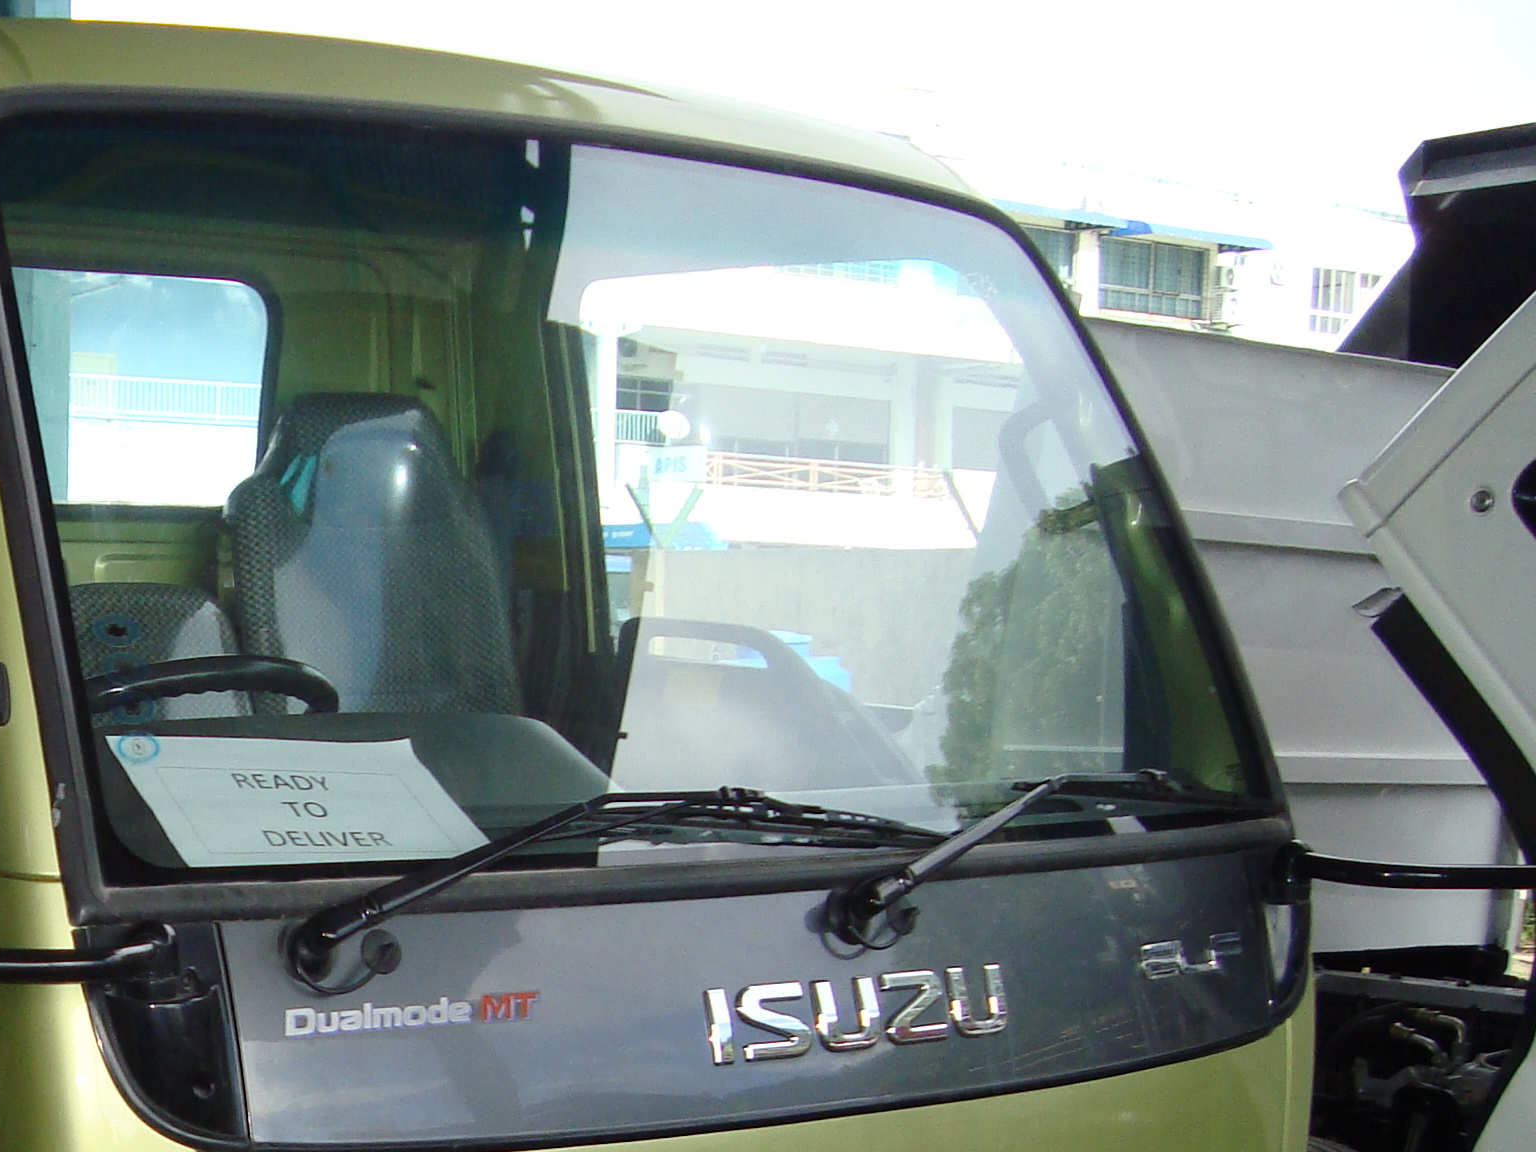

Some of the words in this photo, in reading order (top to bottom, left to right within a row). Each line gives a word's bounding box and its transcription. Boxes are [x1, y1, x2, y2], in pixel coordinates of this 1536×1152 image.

[654, 456, 687, 475] APIS
[231, 772, 330, 793] READY
[281, 800, 328, 819] TO
[262, 829, 393, 849] DELIVER
[284, 996, 473, 1038] Dualmode
[478, 989, 541, 1025] MT
[703, 961, 1008, 1067] ISUZU
